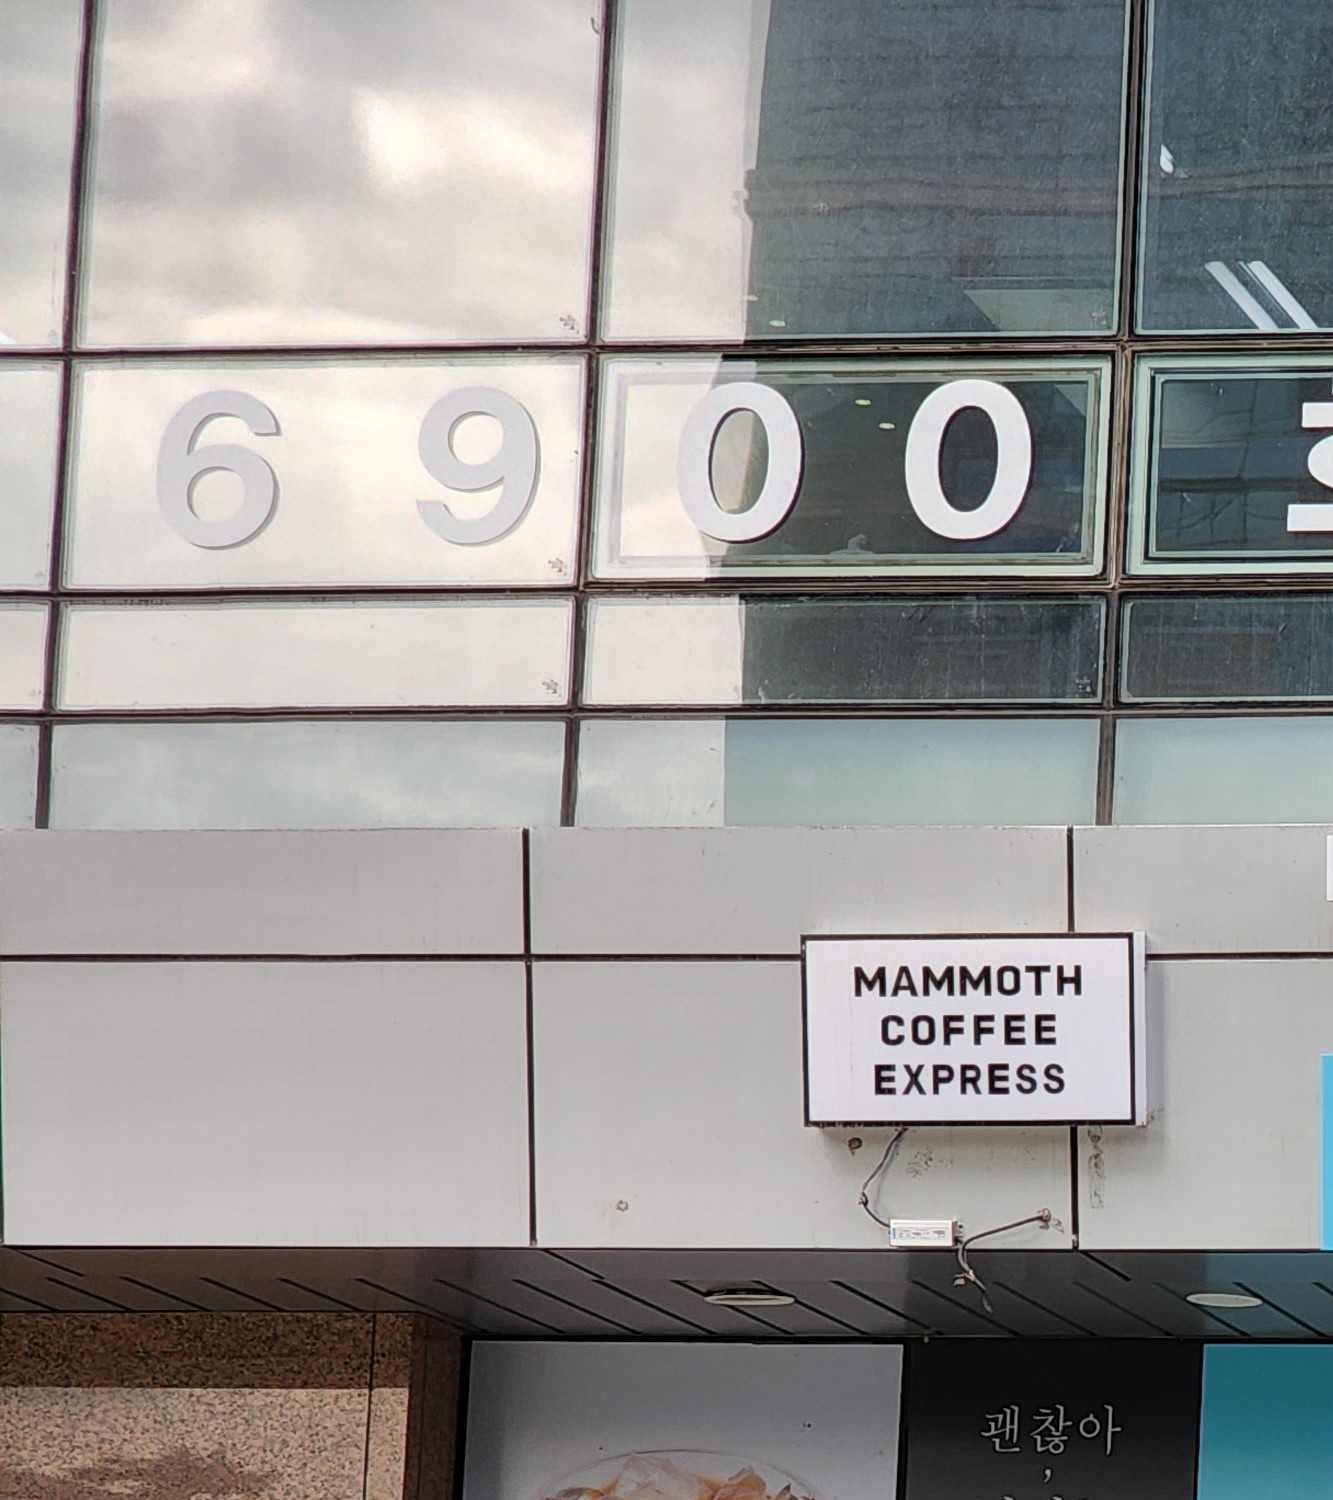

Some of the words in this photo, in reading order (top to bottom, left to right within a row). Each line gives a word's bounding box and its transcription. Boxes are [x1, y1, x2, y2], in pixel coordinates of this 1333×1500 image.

[854, 965, 1082, 998] MAMMOTH
[880, 1013, 1058, 1046] COFFEE
[873, 1063, 1066, 1096] EXPRESS
[980, 1404, 1122, 1456] 괜찮아
